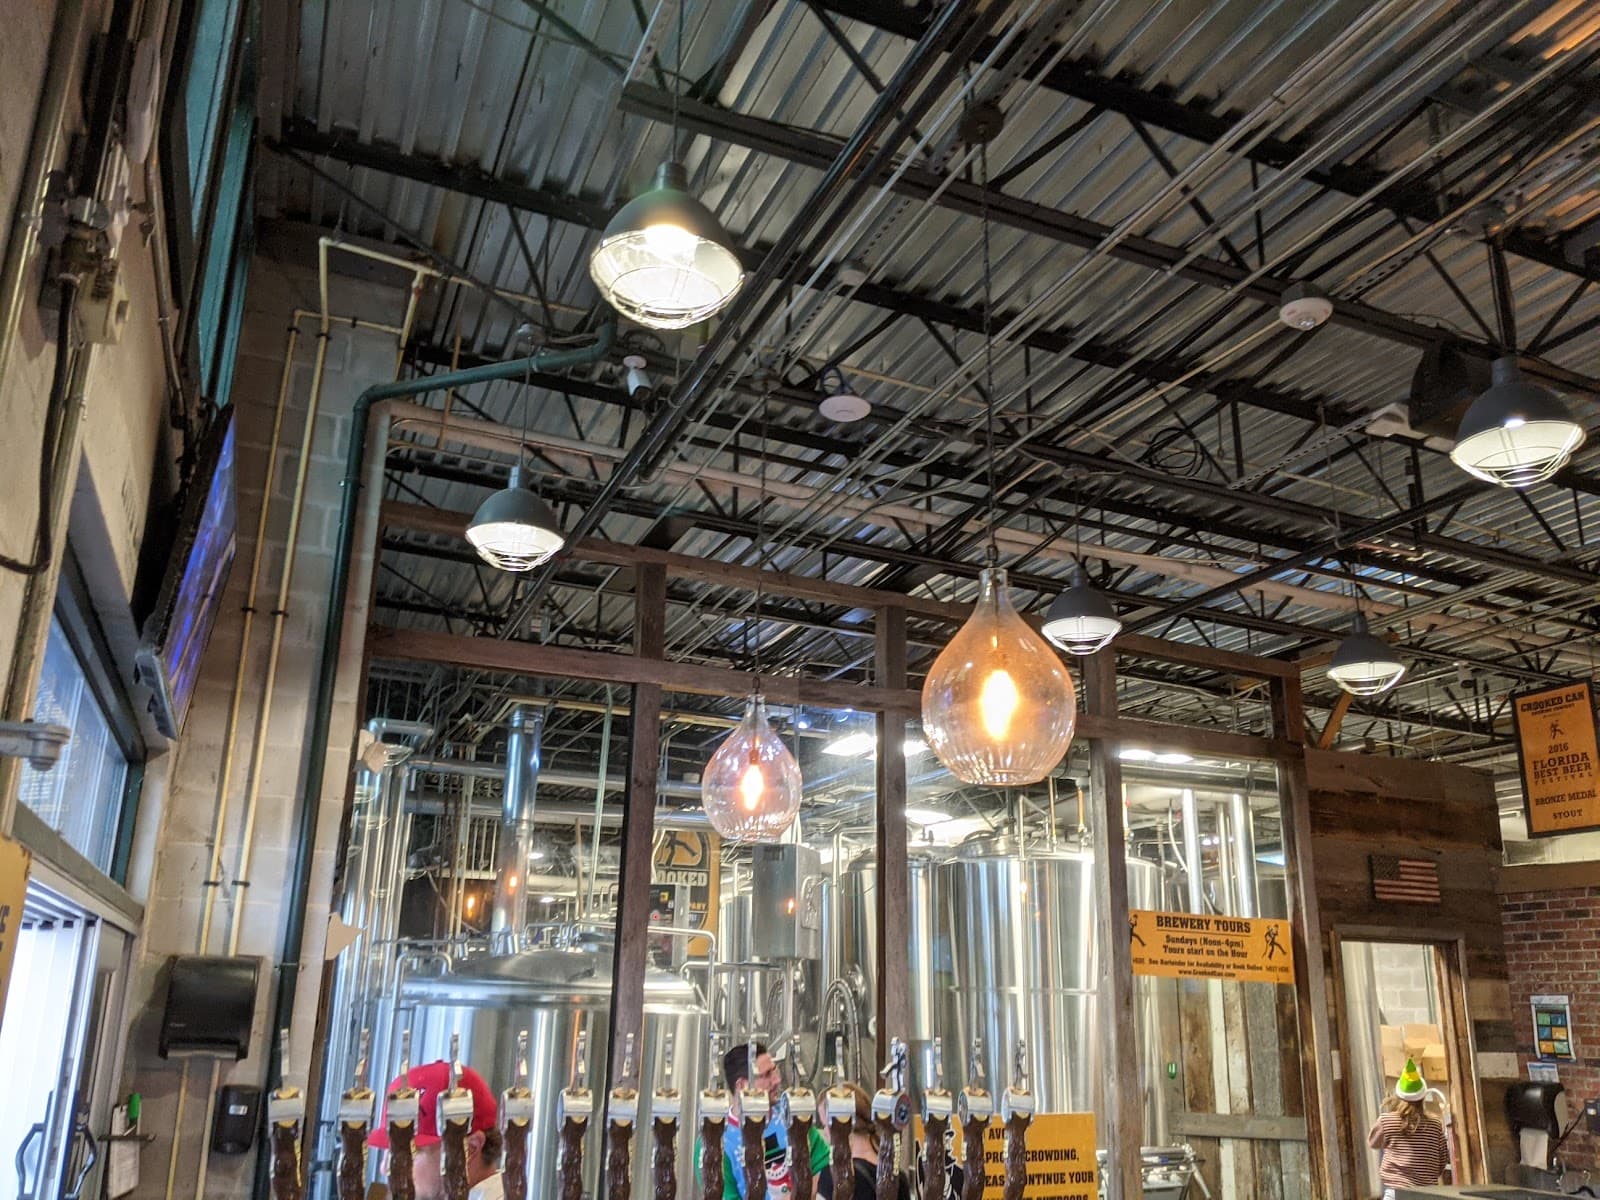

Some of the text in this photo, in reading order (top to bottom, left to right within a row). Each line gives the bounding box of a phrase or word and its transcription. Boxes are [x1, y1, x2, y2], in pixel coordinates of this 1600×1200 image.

[1521, 691, 1585, 713] CROOKED CAN
[1548, 742, 1569, 754] 2016
[1533, 752, 1590, 770] FLORIDA
[1534, 762, 1592, 780] BEST BEER
[1535, 771, 1593, 786] FESTIVAL
[1536, 788, 1597, 806] BRONZE MEDAL
[1553, 808, 1583, 819] STOUT
[1156, 915, 1251, 933] BREWERY TOURS
[1165, 934, 1244, 949] Sundays (Noon-4pm)
[1163, 944, 1185, 954] Tours
[1187, 947, 1204, 955] start
[1217, 948, 1229, 957] the
[1231, 949, 1248, 959] Hour
[1025, 1148, 1080, 1162] CROWDING,
[1069, 1170, 1094, 1184] YOUR
